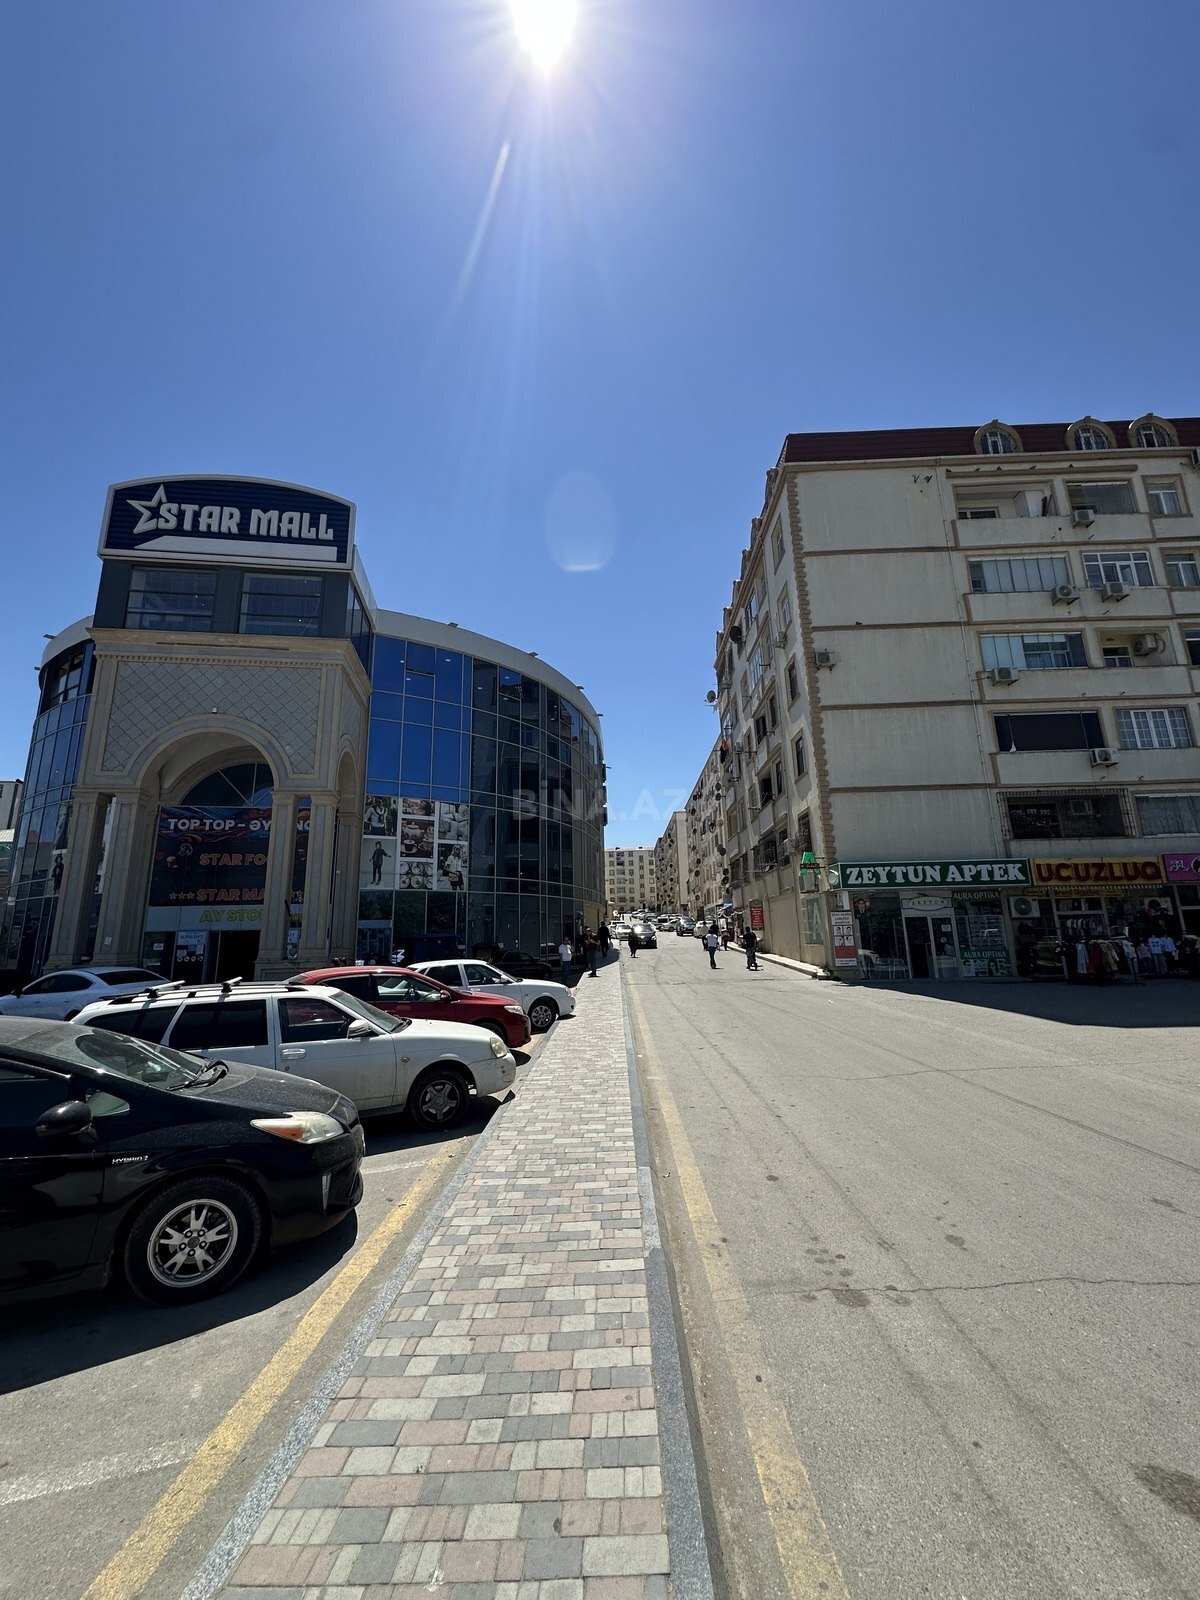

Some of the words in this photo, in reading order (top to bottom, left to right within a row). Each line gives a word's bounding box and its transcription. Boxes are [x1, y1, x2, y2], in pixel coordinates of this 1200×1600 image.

[158, 503, 241, 534] STAR
[249, 508, 334, 540] MALL
[167, 818, 200, 831] TOP
[203, 819, 235, 831] TOP
[199, 853, 242, 867] STAR
[845, 864, 942, 885] ZEYTUN
[945, 863, 1026, 883] APTEK
[1036, 861, 1162, 882] UCUZLUQ
[195, 887, 241, 902] STAR
[953, 892, 973, 900] AURA
[199, 910, 225, 923] AY
[226, 909, 264, 922] STO
[963, 951, 982, 959] AURA
